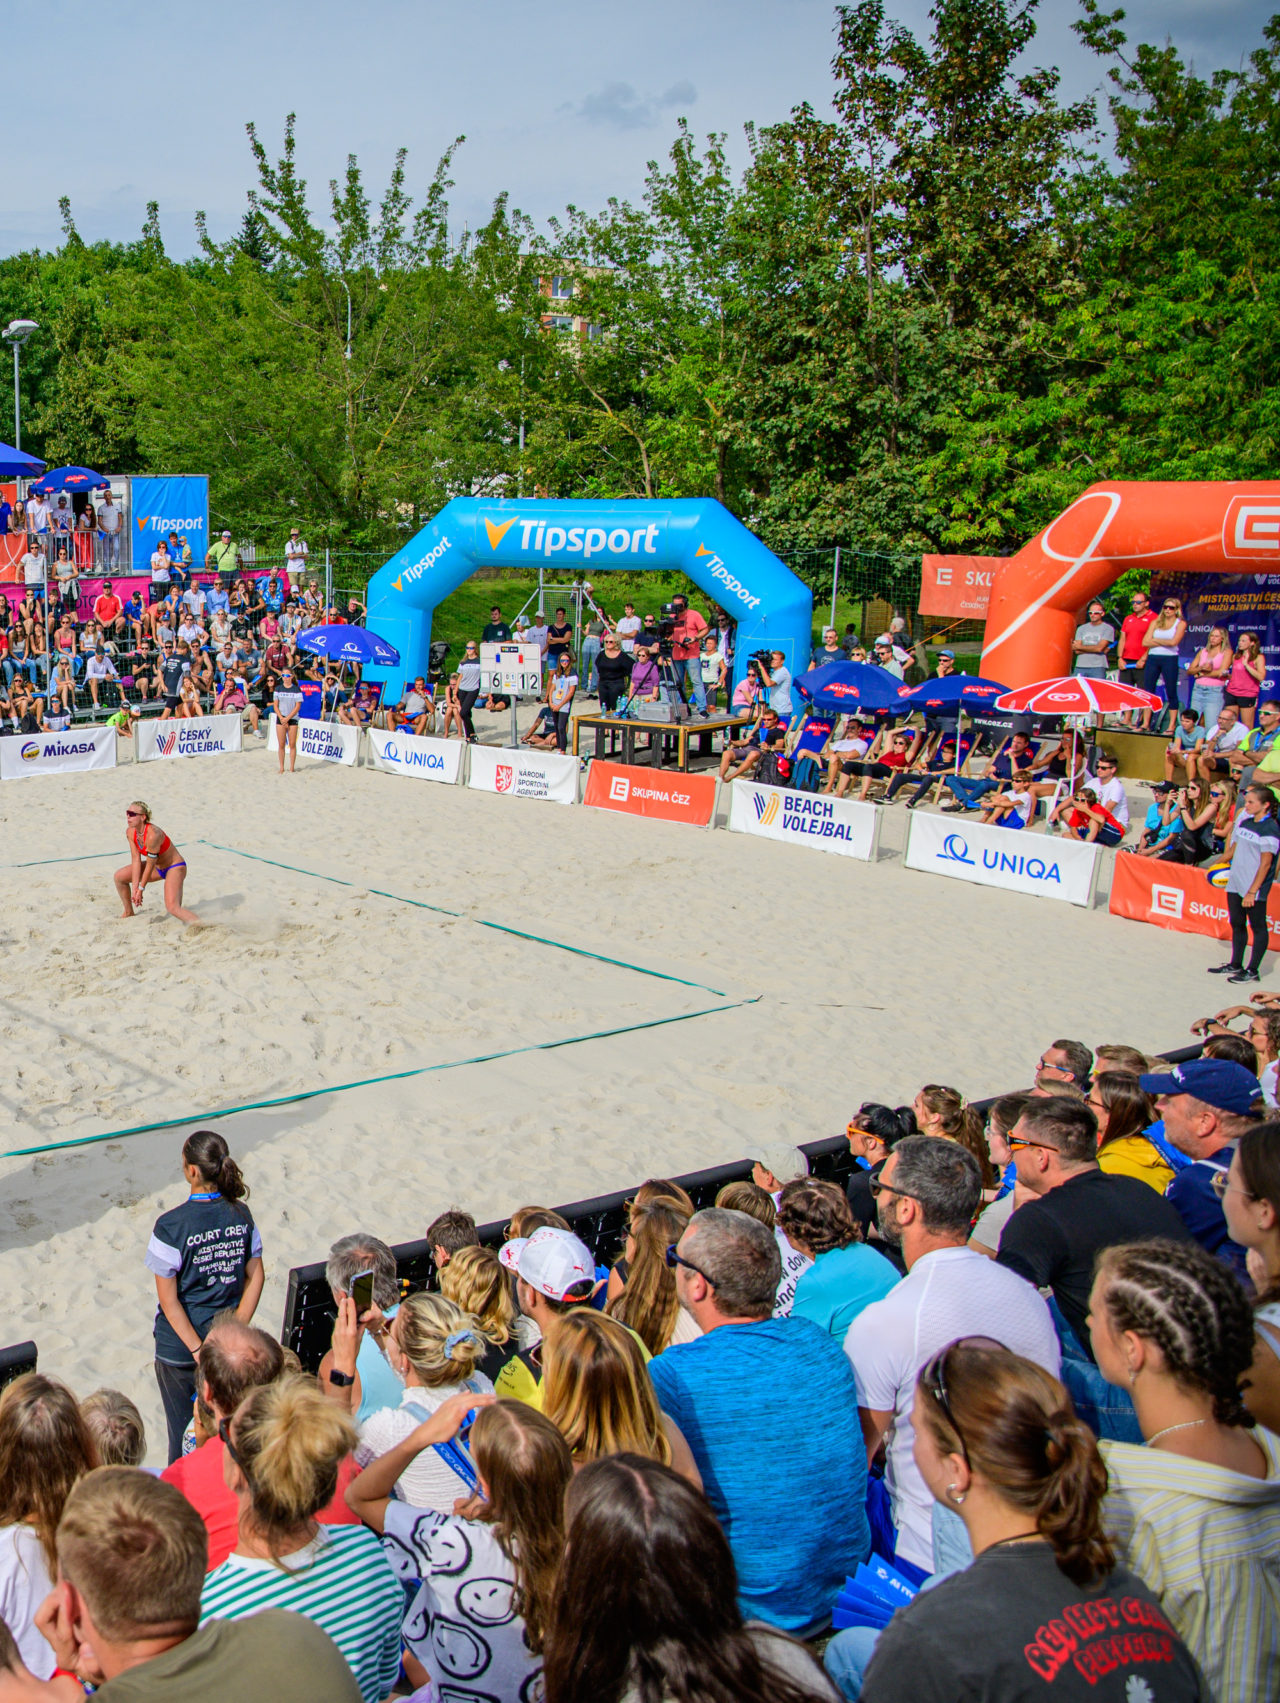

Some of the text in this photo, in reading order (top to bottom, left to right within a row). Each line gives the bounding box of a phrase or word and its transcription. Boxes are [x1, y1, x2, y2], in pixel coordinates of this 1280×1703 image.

[151, 516, 203, 533] Tipsport
[520, 520, 659, 557] Tipsport
[402, 536, 452, 583] Tipsport
[706, 555, 761, 609] Tipsport
[1199, 592, 1280, 603] MISTROVSTVÍ ČES
[493, 673, 500, 687] 6
[829, 685, 857, 694] MATTONI
[179, 726, 212, 741] ČESKÝ
[302, 728, 332, 743] BEACH
[178, 740, 225, 754] VOLEJBAL
[301, 741, 343, 759] VOLEJBAL
[404, 750, 444, 770] UNIQA
[518, 778, 549, 788] SPORTOVNÍ
[519, 770, 545, 779] NÁRODNÍ
[516, 788, 547, 797] AGENTURA
[632, 786, 669, 803] SKUPINA
[671, 790, 690, 806] ČEZ
[784, 796, 833, 818] BEACH
[782, 814, 852, 841] VOLEJBAL
[982, 848, 1061, 883] UNIQA
[1189, 901, 1229, 921] SKUP
[187, 1224, 248, 1246] COURT CREW
[774, 1283, 795, 1308] and
[1024, 1619, 1078, 1683] RED
[1063, 1597, 1120, 1640] HOT
[1073, 1631, 1175, 1685] PEPPERS
